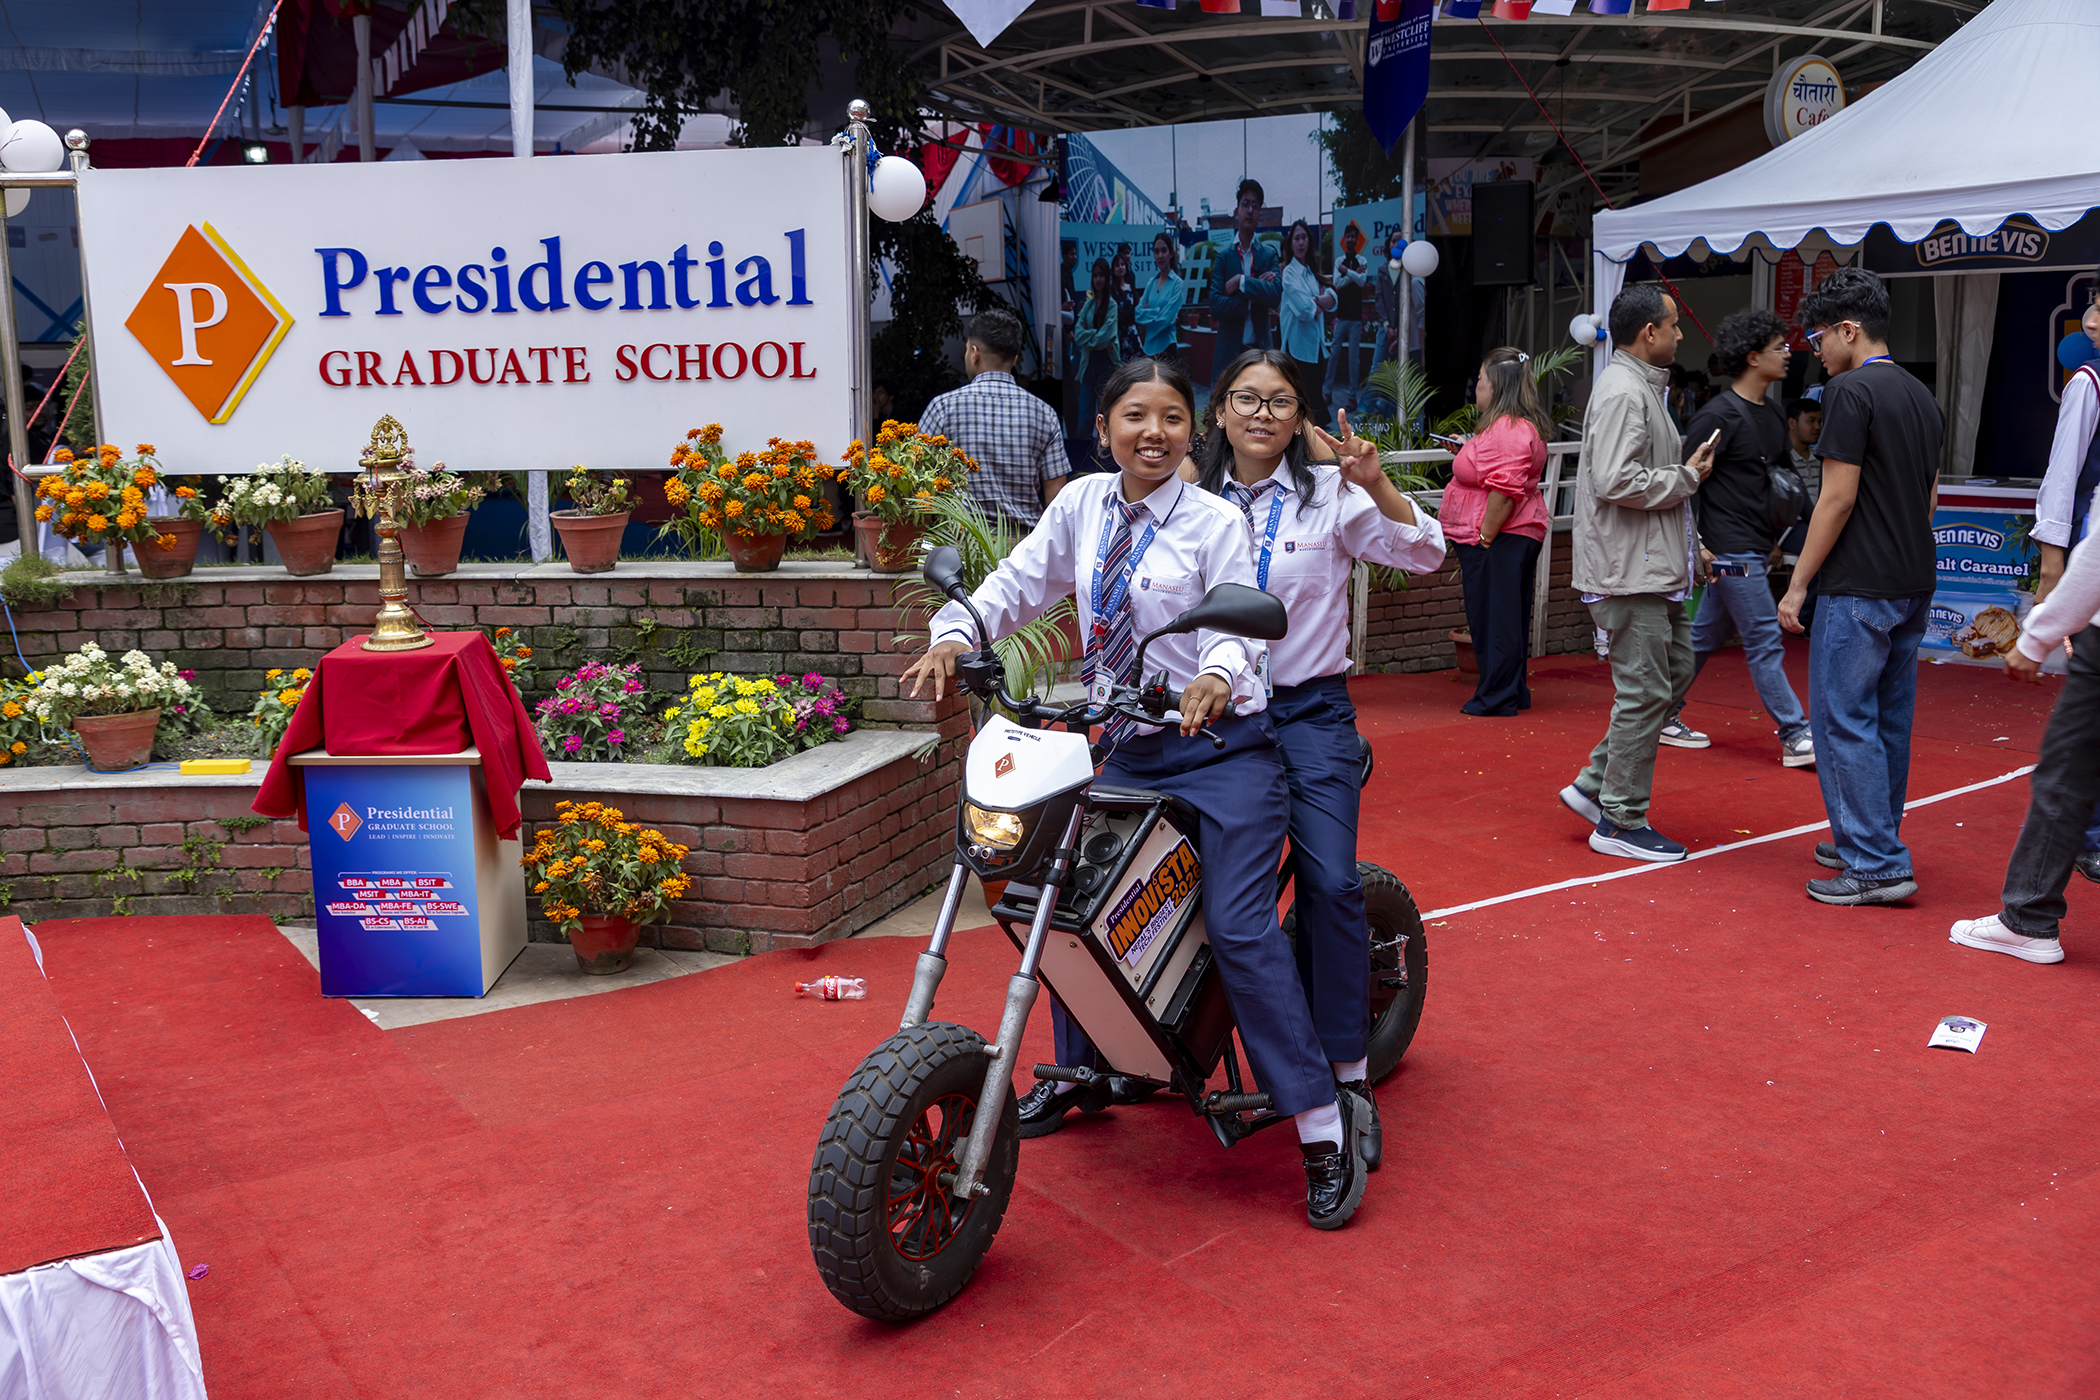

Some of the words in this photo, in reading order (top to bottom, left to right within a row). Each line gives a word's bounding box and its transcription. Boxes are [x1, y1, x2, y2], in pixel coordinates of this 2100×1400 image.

[1384, 20, 1430, 45] WESTCLIFF
[1382, 33, 1429, 54] UNIVERSITY
[1793, 74, 1838, 107] चौतारी
[1472, 169, 1492, 182] ARE
[1923, 233, 1967, 261] BEN
[1971, 230, 2041, 256] NEVIS
[314, 228, 814, 317] Presidential
[163, 282, 228, 366] P
[319, 346, 591, 386] GRADUATE
[615, 341, 817, 382] SCHOOL
[1266, 503, 1278, 533] MANASLU
[1130, 531, 1149, 561] MANASLU
[1958, 530, 1999, 548] NEVIS
[1936, 558, 1956, 570] alt
[1960, 559, 2029, 576] Caramel
[1151, 581, 1184, 592] MANASLU
[1105, 582, 1122, 613] MANASLU
[1936, 609, 1963, 624] NEVIS
[336, 813, 351, 831] P
[367, 806, 454, 820] Presidential
[368, 823, 416, 831] GRADUATE
[418, 823, 455, 831] SCHOOL
[359, 890, 379, 898] MSIT
[400, 890, 430, 898] MBA-IT
[1172, 864, 1202, 906] 2026
[332, 902, 365, 910] MBA-DA
[381, 902, 412, 910] MBA-FE
[427, 902, 458, 910] BS-SWE
[1110, 883, 1142, 924] Presidential
[365, 917, 389, 925] BS-CS
[404, 917, 426, 925] BS-AI
[1131, 926, 1151, 954] NEPAL'S
[1150, 901, 1172, 928] BIGGEST
[1139, 934, 1153, 953] TECH
[1152, 908, 1174, 937] FESTIVAL
